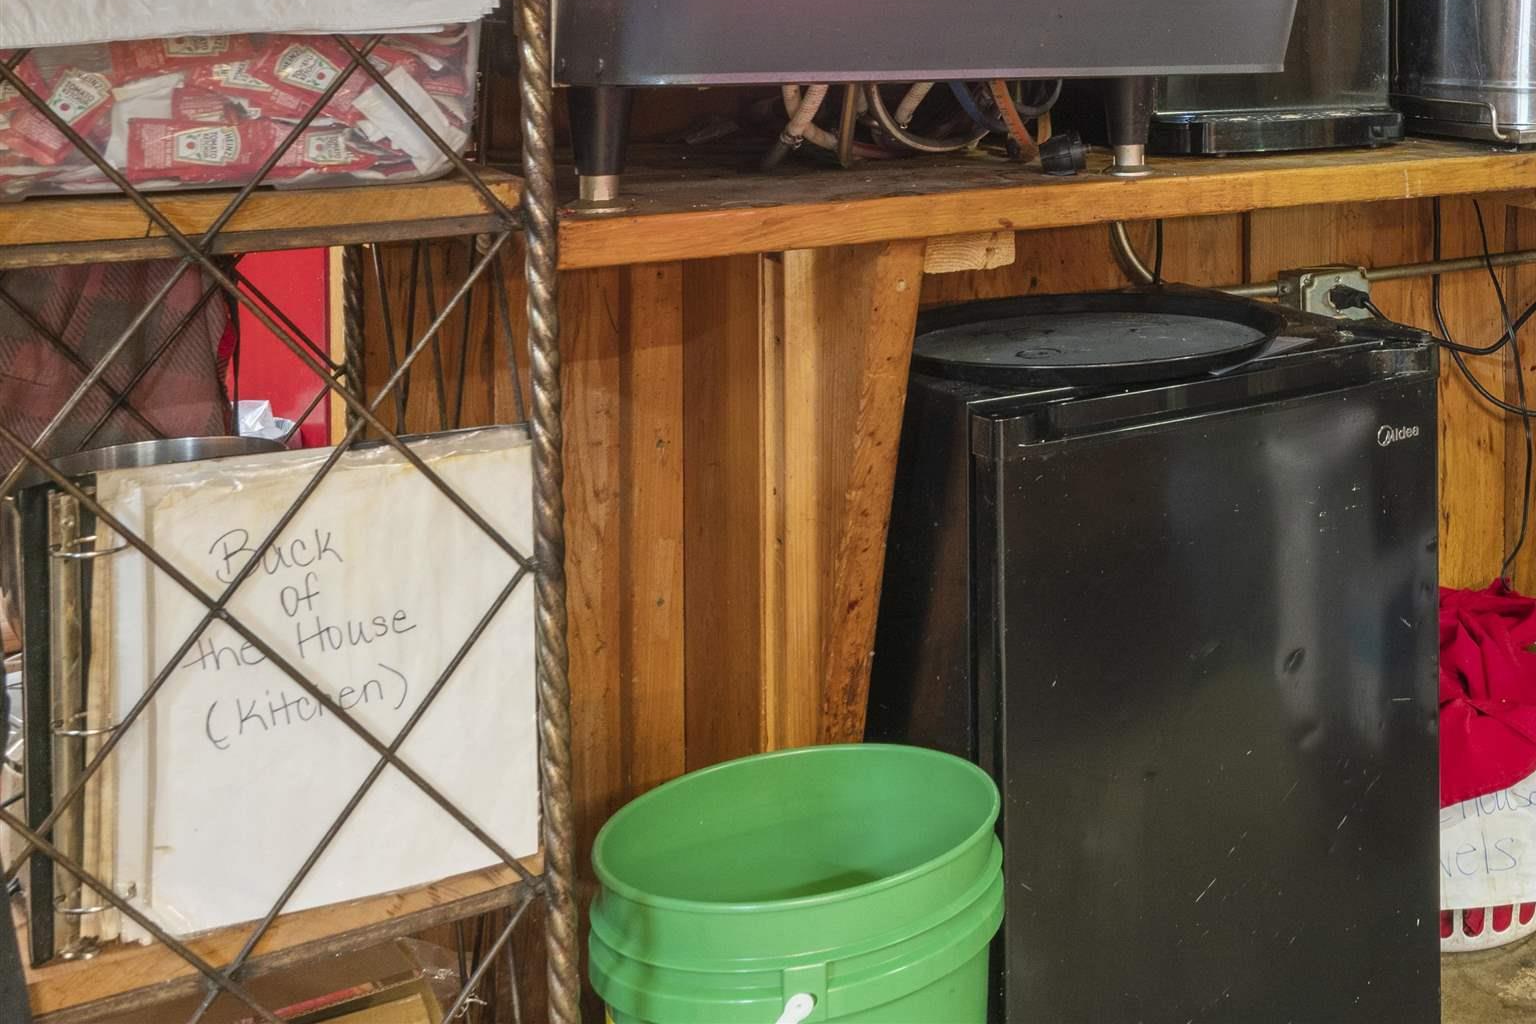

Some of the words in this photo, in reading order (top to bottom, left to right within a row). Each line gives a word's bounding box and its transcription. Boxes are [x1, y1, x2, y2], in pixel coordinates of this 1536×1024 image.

[210, 131, 218, 159] TOMATO
[224, 129, 233, 162] HEINZ
[1377, 424, 1420, 447] Midea
[209, 528, 343, 583] Back
[183, 639, 266, 671] the
[297, 607, 418, 659] House
